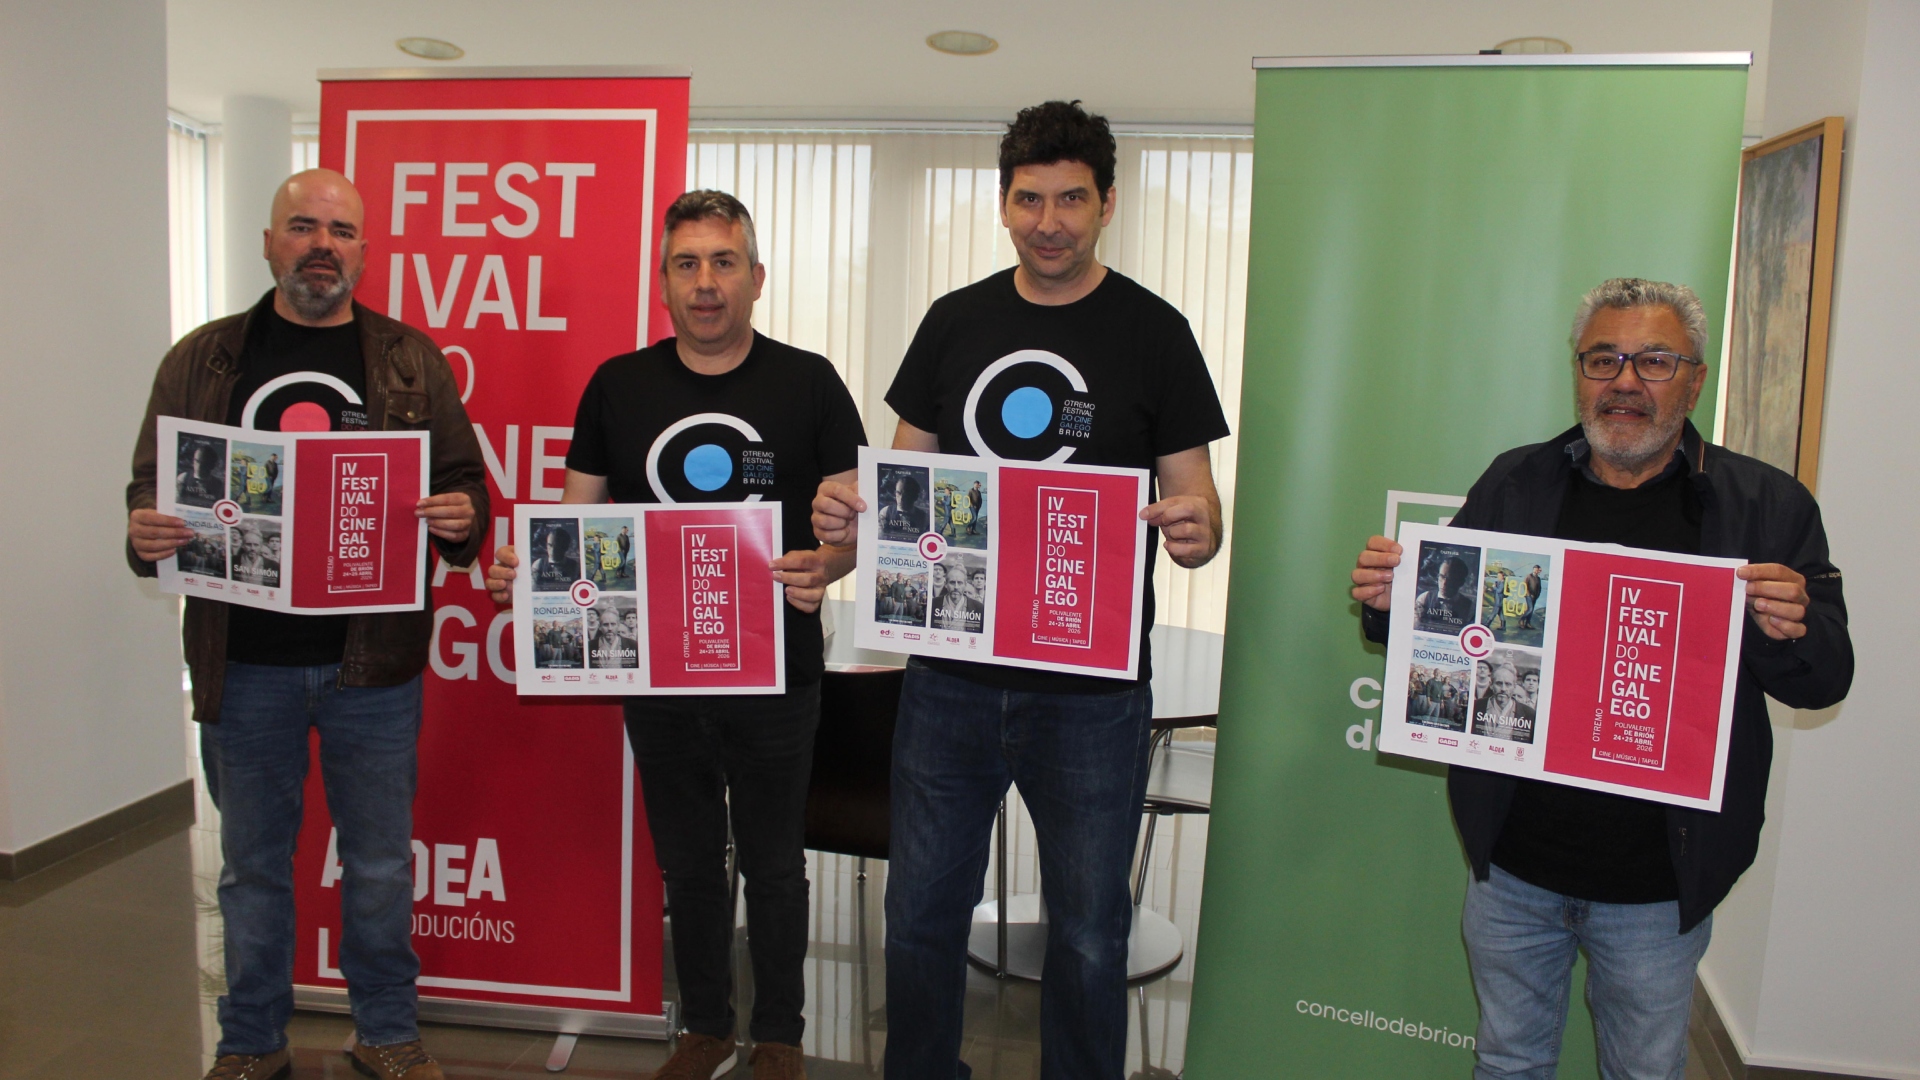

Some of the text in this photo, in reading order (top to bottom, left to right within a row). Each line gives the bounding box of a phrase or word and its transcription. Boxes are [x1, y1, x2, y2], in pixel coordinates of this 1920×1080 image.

[390, 161, 596, 239] FEST
[387, 253, 567, 331] IVAL
[1062, 407, 1094, 418] FESTIVAL
[1064, 400, 1096, 411] OTREMO
[1059, 421, 1091, 432] GALEGO
[1061, 414, 1093, 425] DO CINE
[1058, 428, 1090, 439] BRIÓN
[742, 450, 775, 459] OTREMO
[742, 457, 775, 465] FESTIVAL
[342, 462, 358, 476] IV
[472, 424, 575, 502] NE
[743, 471, 774, 479] GALEGO
[341, 477, 379, 491] FEST
[341, 492, 375, 505] IVAL
[1048, 496, 1064, 511] IV
[340, 506, 358, 517] DO
[339, 518, 377, 531] CINE
[888, 519, 911, 528] ANTES
[1047, 512, 1088, 529] FEST
[338, 532, 369, 545] GAL
[691, 533, 706, 548] IV
[1047, 528, 1083, 545] IVAL
[338, 545, 370, 559] EGO
[691, 548, 729, 562] FEST
[1047, 544, 1066, 557] DO
[233, 565, 250, 573] SAN
[878, 556, 928, 569] RONDALLAS
[1046, 557, 1085, 575] CINE
[692, 563, 726, 578] IVAL
[692, 578, 710, 591] DO
[1045, 573, 1077, 590] GAL
[692, 591, 729, 605] CINE
[1045, 589, 1078, 607] EGO
[1621, 586, 1641, 605] IV
[533, 607, 581, 615] RONDALLAS
[692, 606, 723, 620] GAL
[934, 608, 981, 621] SAN SIMÓN
[1031, 599, 1040, 629] OTREMO
[1049, 609, 1082, 618] POLIVALENTE
[1426, 607, 1453, 618] ANTES
[1619, 605, 1669, 628] FEST
[693, 621, 725, 635] EGO
[1617, 625, 1661, 647] IVAL
[591, 648, 636, 658] SAN SIMÓN
[1413, 649, 1470, 666] RONDALLAS
[1615, 644, 1639, 660] DO
[1613, 660, 1662, 683] CINE
[1611, 679, 1650, 701] GAL
[1610, 697, 1651, 720] EGO
[1476, 711, 1532, 730] SAN SIMÓN
[1592, 708, 1604, 742] OTREMO
[1614, 721, 1655, 734] POLIVALENTE
[1624, 729, 1655, 740] DE BRIÓN
[1439, 738, 1459, 746] GADIS
[1488, 745, 1505, 753] ALDEA
[1634, 738, 1653, 747] ABRIL
[1636, 744, 1653, 753] 2026
[1598, 750, 1659, 765] CINE MÚSICA TAPEO
[411, 911, 515, 944] DUCIÓNS
